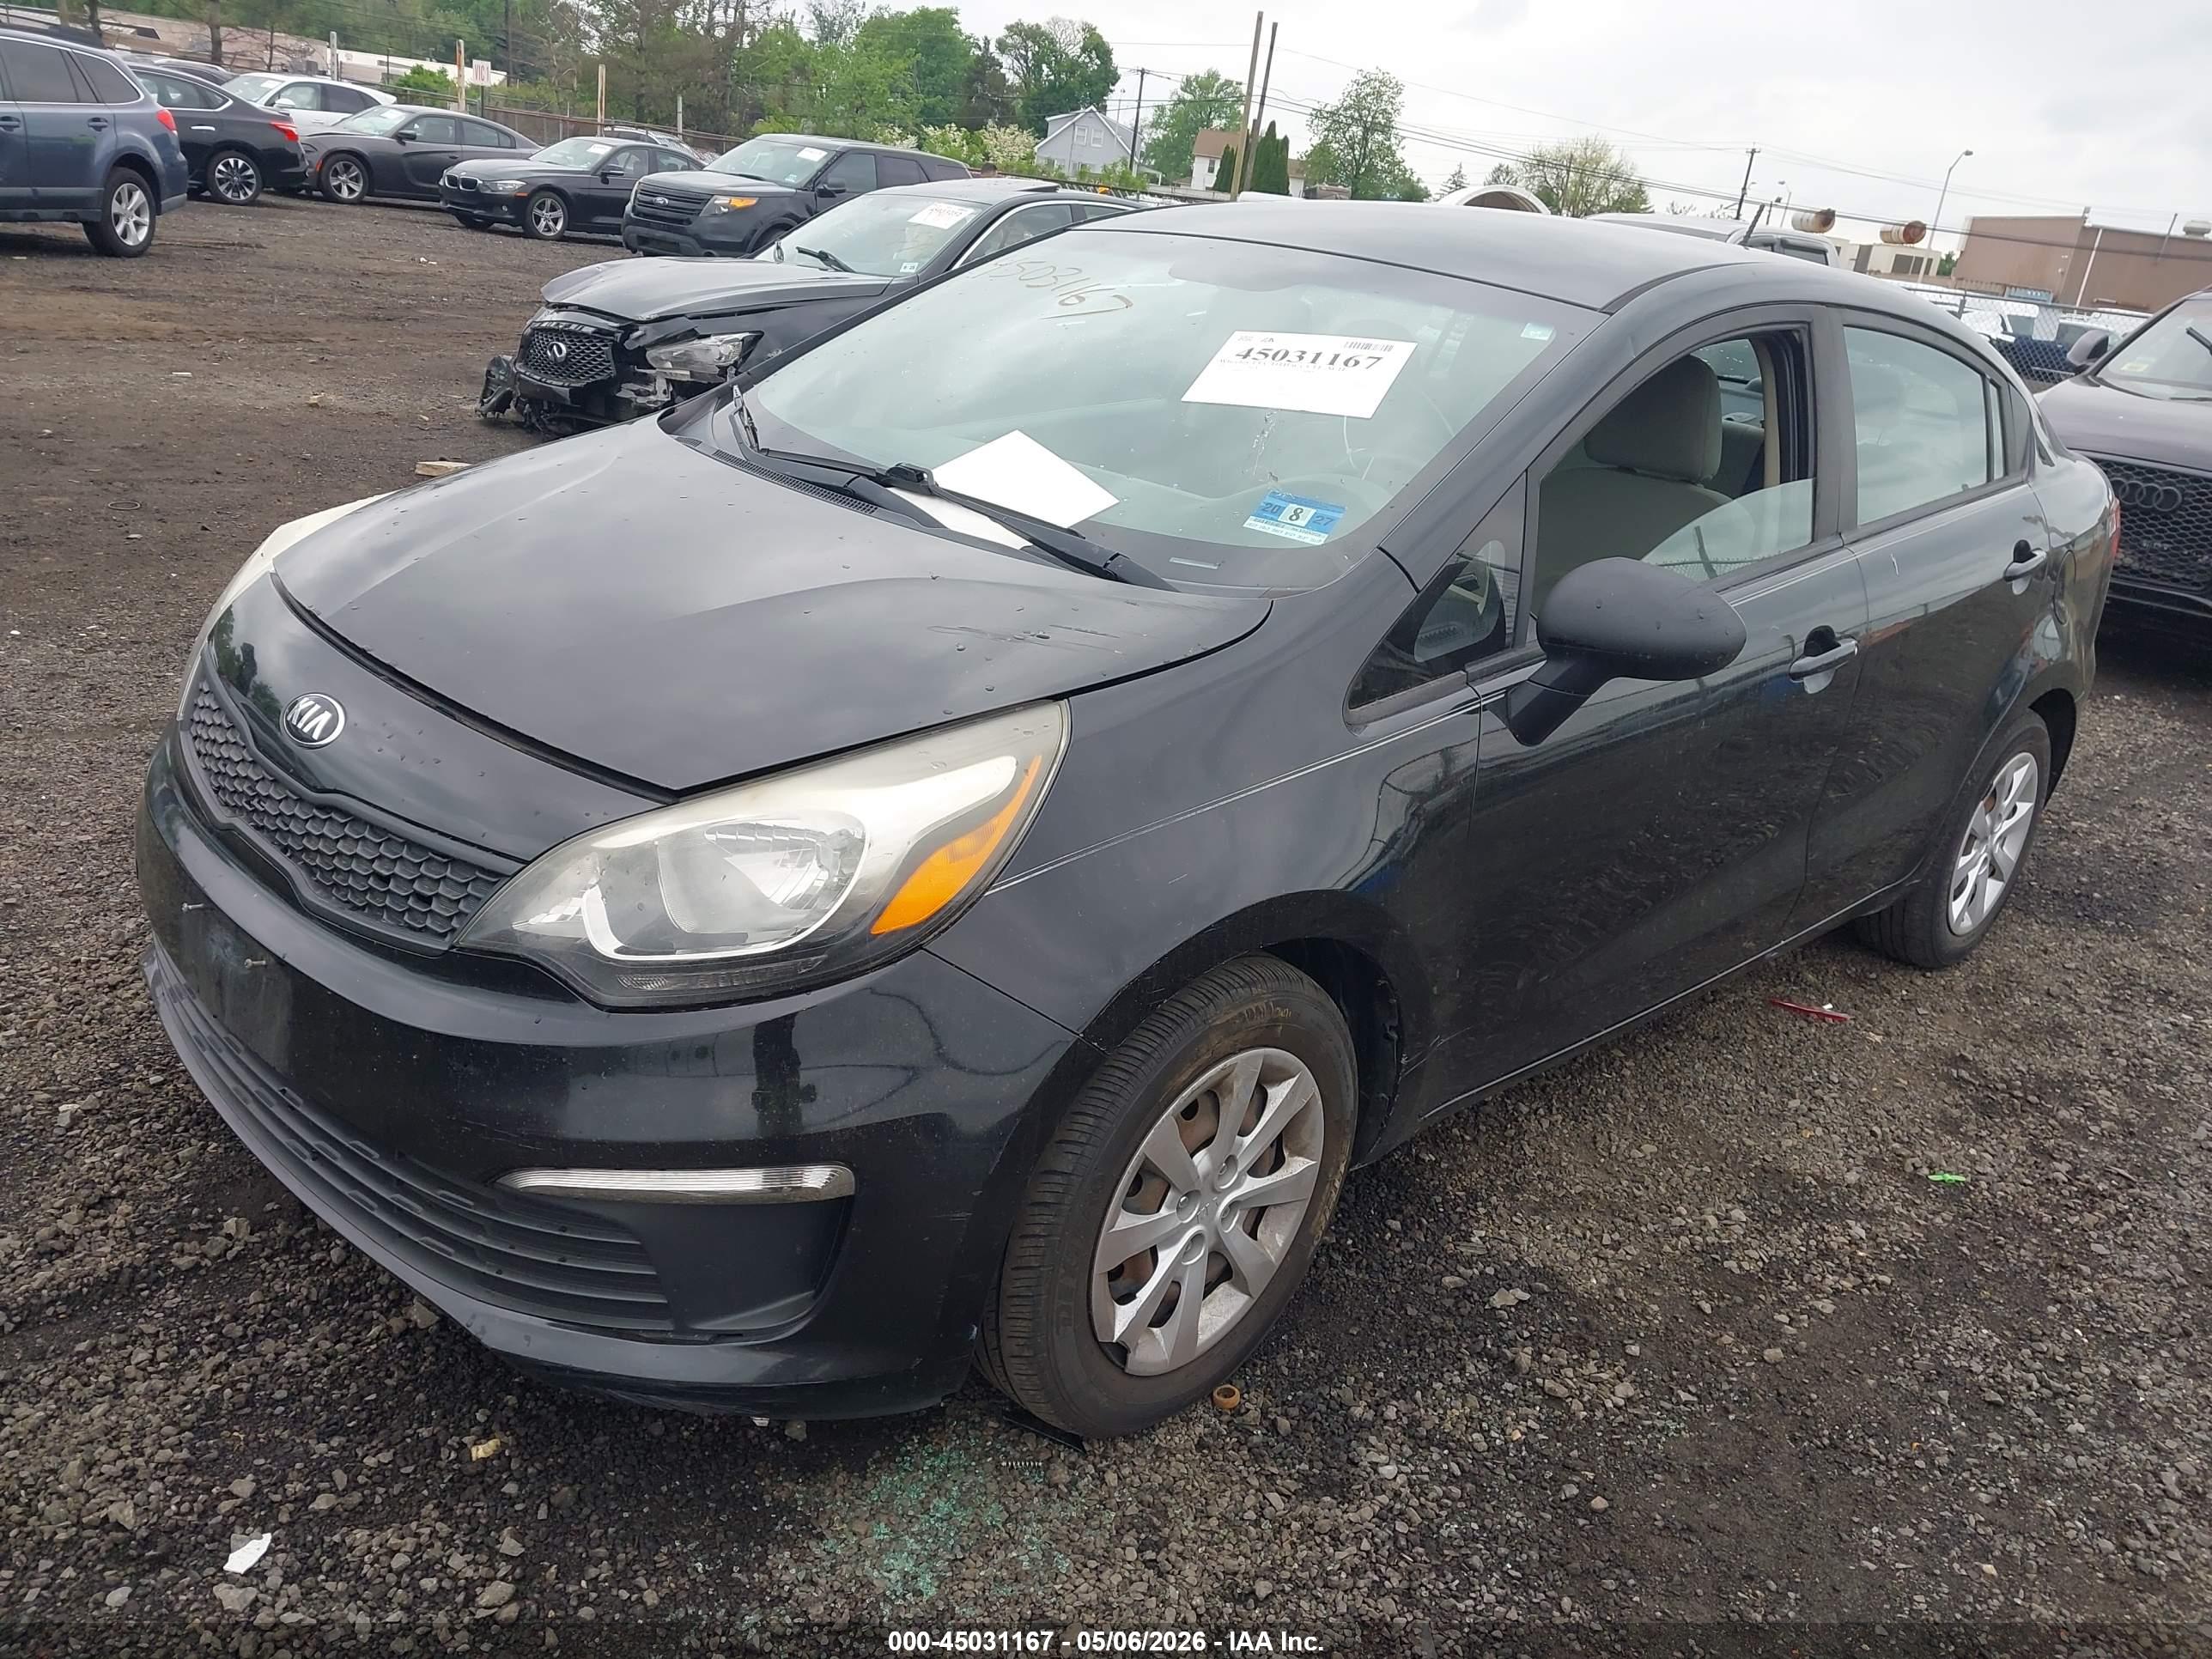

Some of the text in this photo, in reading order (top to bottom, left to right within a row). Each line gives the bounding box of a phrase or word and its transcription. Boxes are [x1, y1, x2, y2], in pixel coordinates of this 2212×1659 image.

[1235, 347, 1383, 370] 45031167
[1261, 501, 1282, 514] 20
[1288, 507, 1304, 522] 8
[1312, 514, 1334, 526] 27
[286, 696, 332, 741] KIA
